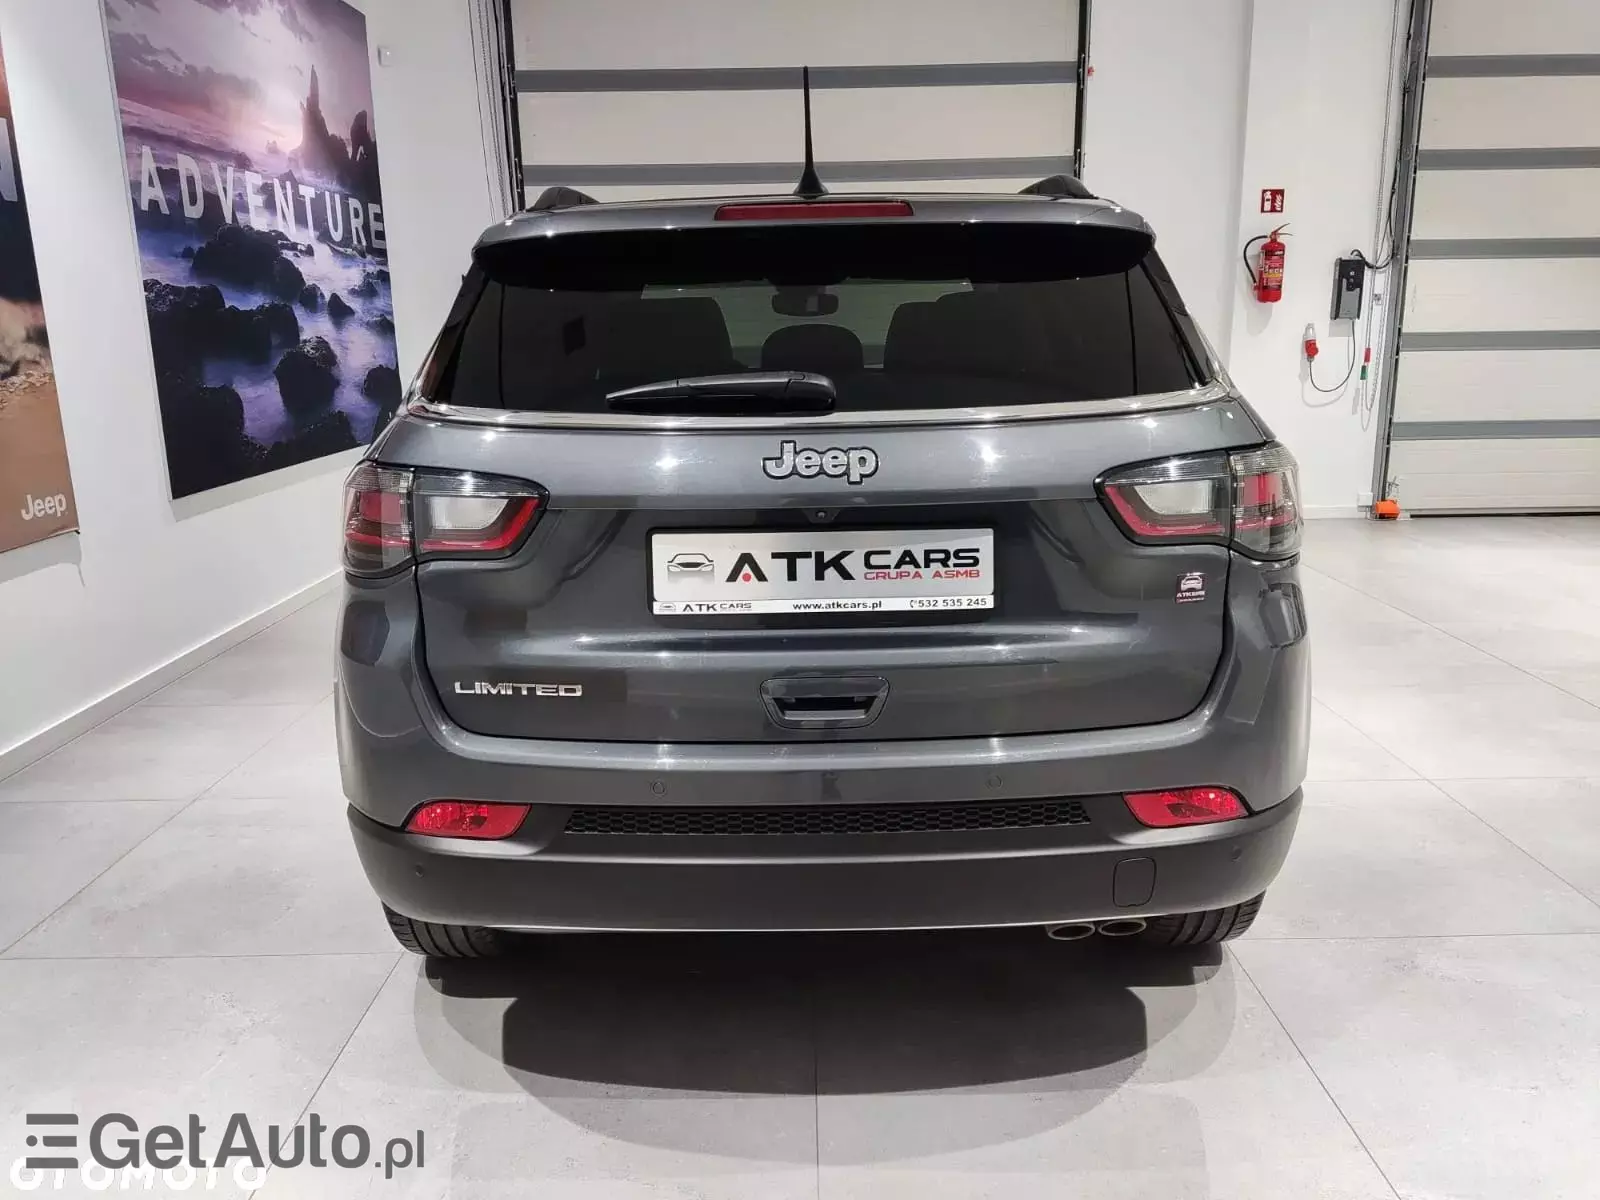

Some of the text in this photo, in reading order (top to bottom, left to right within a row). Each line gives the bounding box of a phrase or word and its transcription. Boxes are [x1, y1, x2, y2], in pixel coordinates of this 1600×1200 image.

[138, 145, 385, 250] ADVENTURE
[762, 440, 879, 484] Jeep
[20, 493, 67, 521] Jeep
[725, 548, 980, 583] ATK CARS
[863, 569, 980, 581] GRUPA ASMB
[682, 603, 717, 613] ATK
[719, 602, 752, 610] CARS
[792, 599, 882, 611] www.atkcars.pl
[918, 597, 987, 608] 532 535 245
[454, 681, 583, 697] LIMITED
